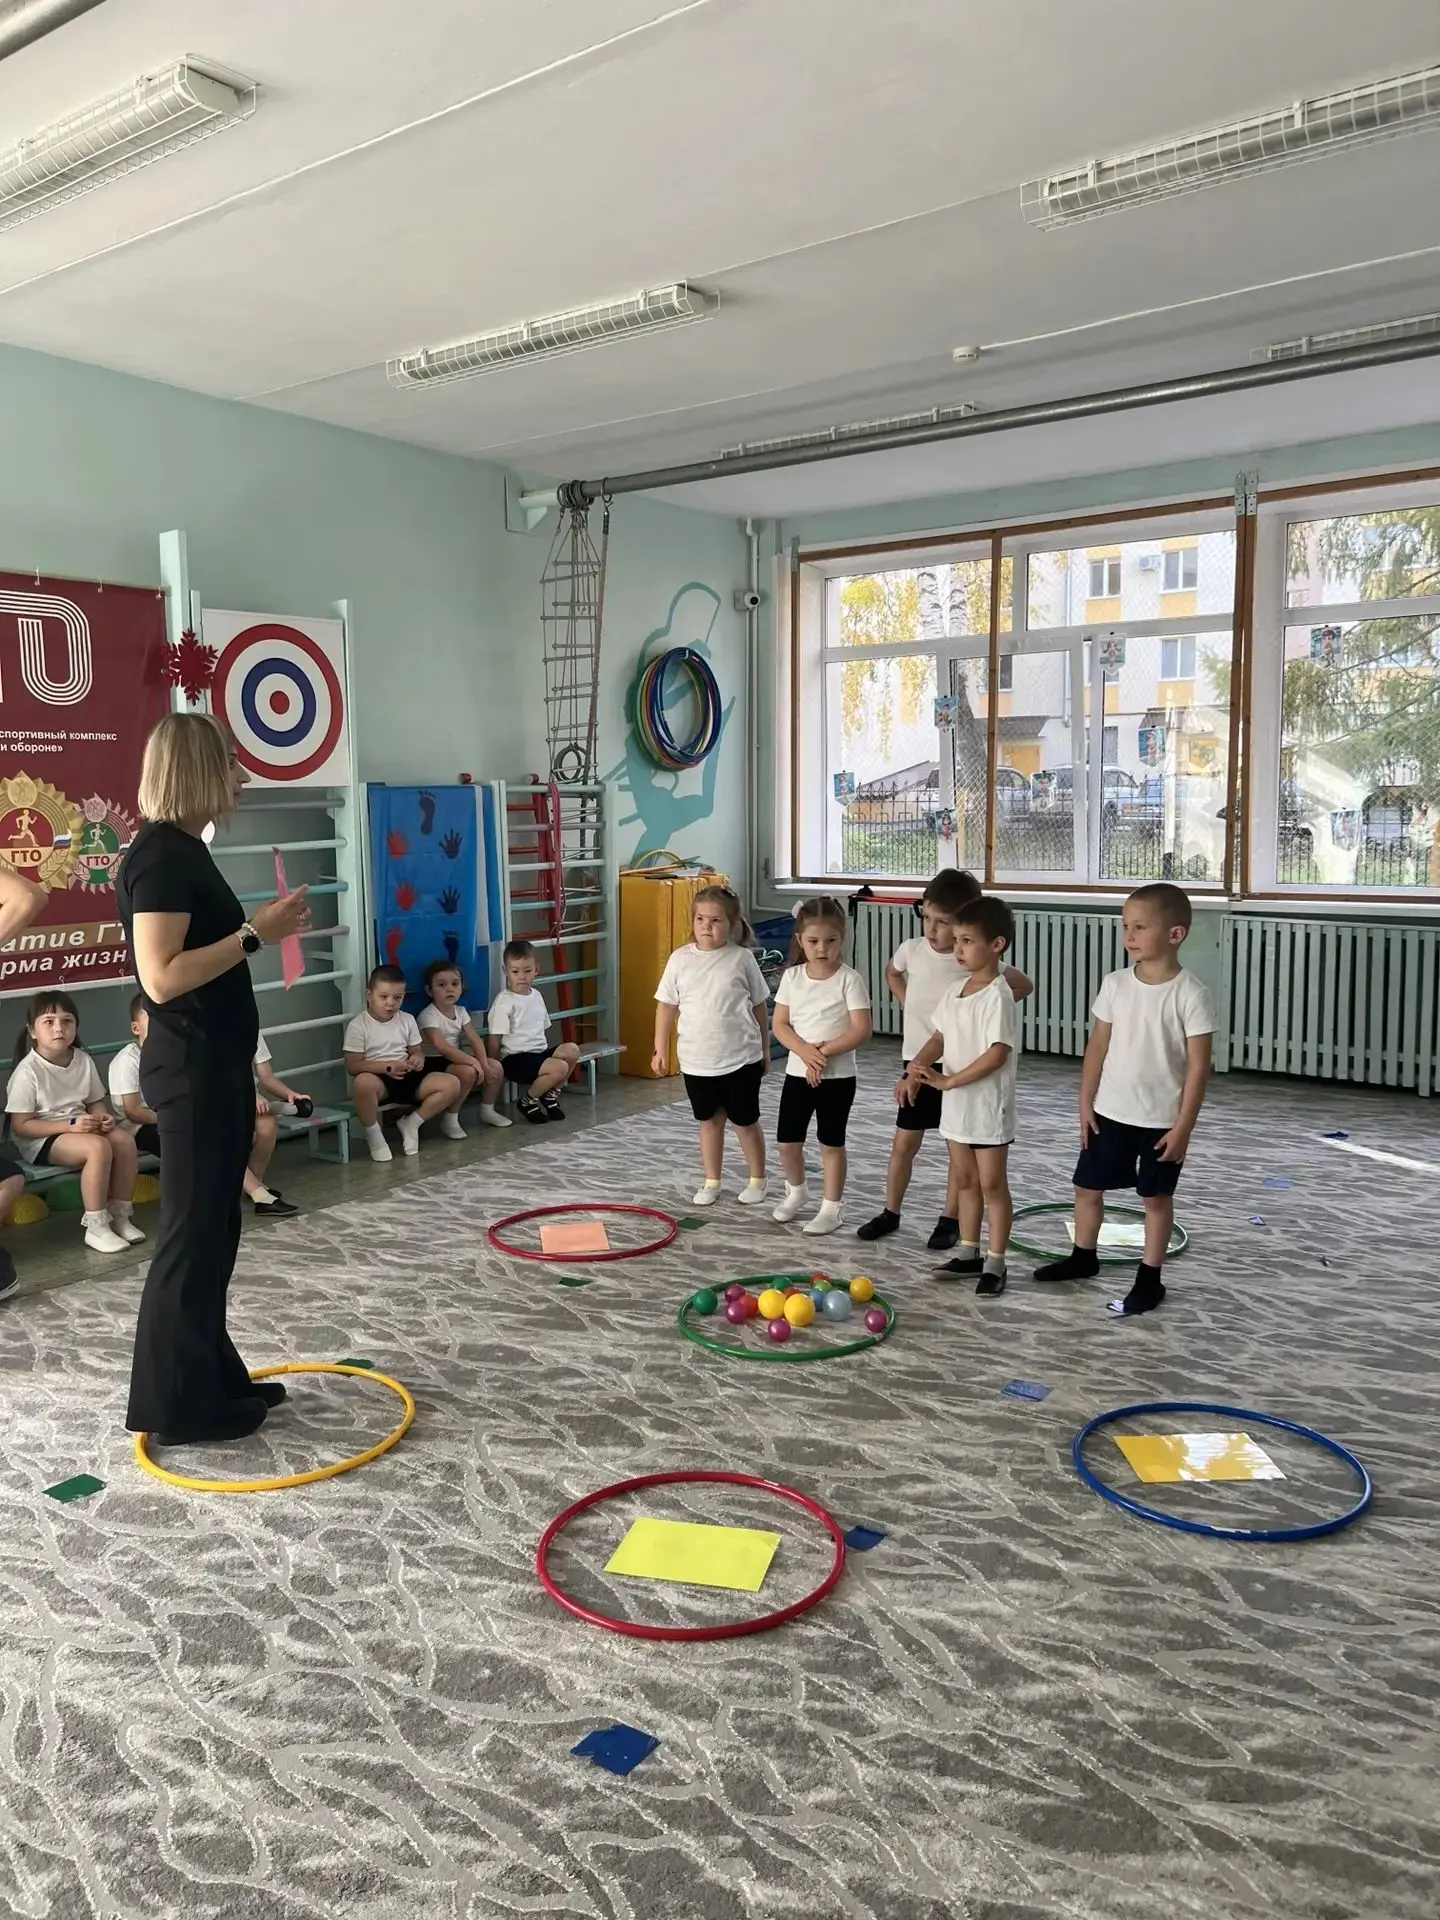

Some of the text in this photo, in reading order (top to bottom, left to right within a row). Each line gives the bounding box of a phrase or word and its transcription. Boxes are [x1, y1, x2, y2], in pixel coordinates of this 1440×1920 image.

[69, 731, 117, 741] комплекс
[0, 742, 63, 754] и обороне»
[11, 849, 42, 863] ГТО
[86, 856, 110, 866] ГТО
[61, 949, 127, 969] жизн
